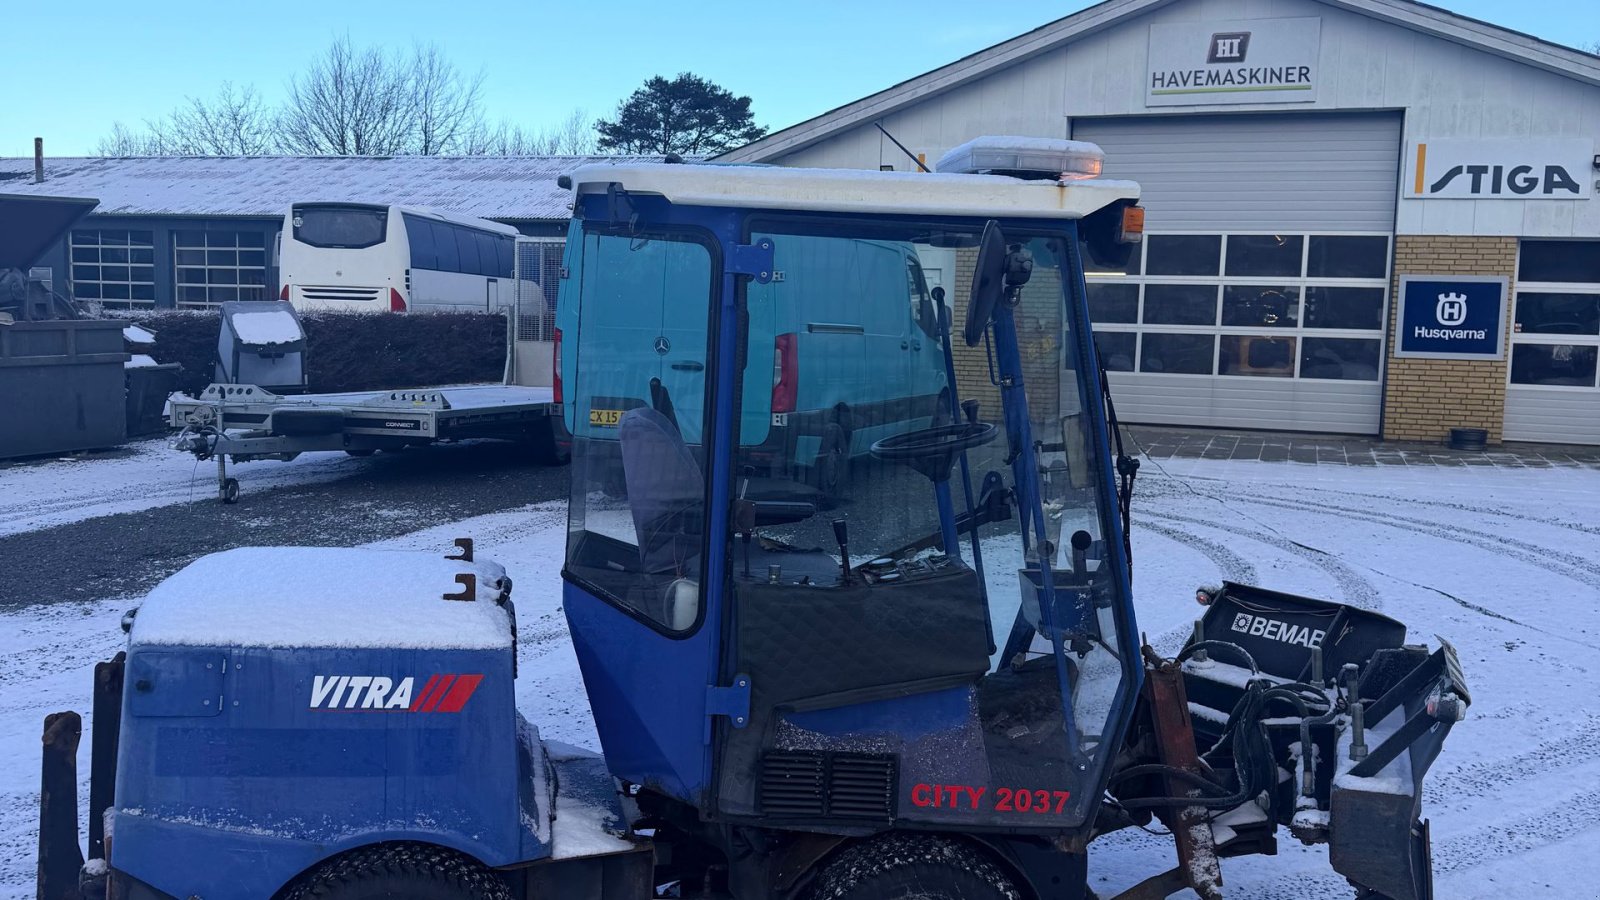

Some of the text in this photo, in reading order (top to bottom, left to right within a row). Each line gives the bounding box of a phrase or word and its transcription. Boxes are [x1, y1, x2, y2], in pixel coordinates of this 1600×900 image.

[1216, 38, 1241, 58] HI
[1152, 66, 1311, 88] HAVEMASKINER
[1430, 165, 1580, 194] STIGA
[1414, 326, 1486, 340] Husqvarna
[310, 676, 414, 709] VITRA
[911, 783, 1071, 814] CITY 2037
